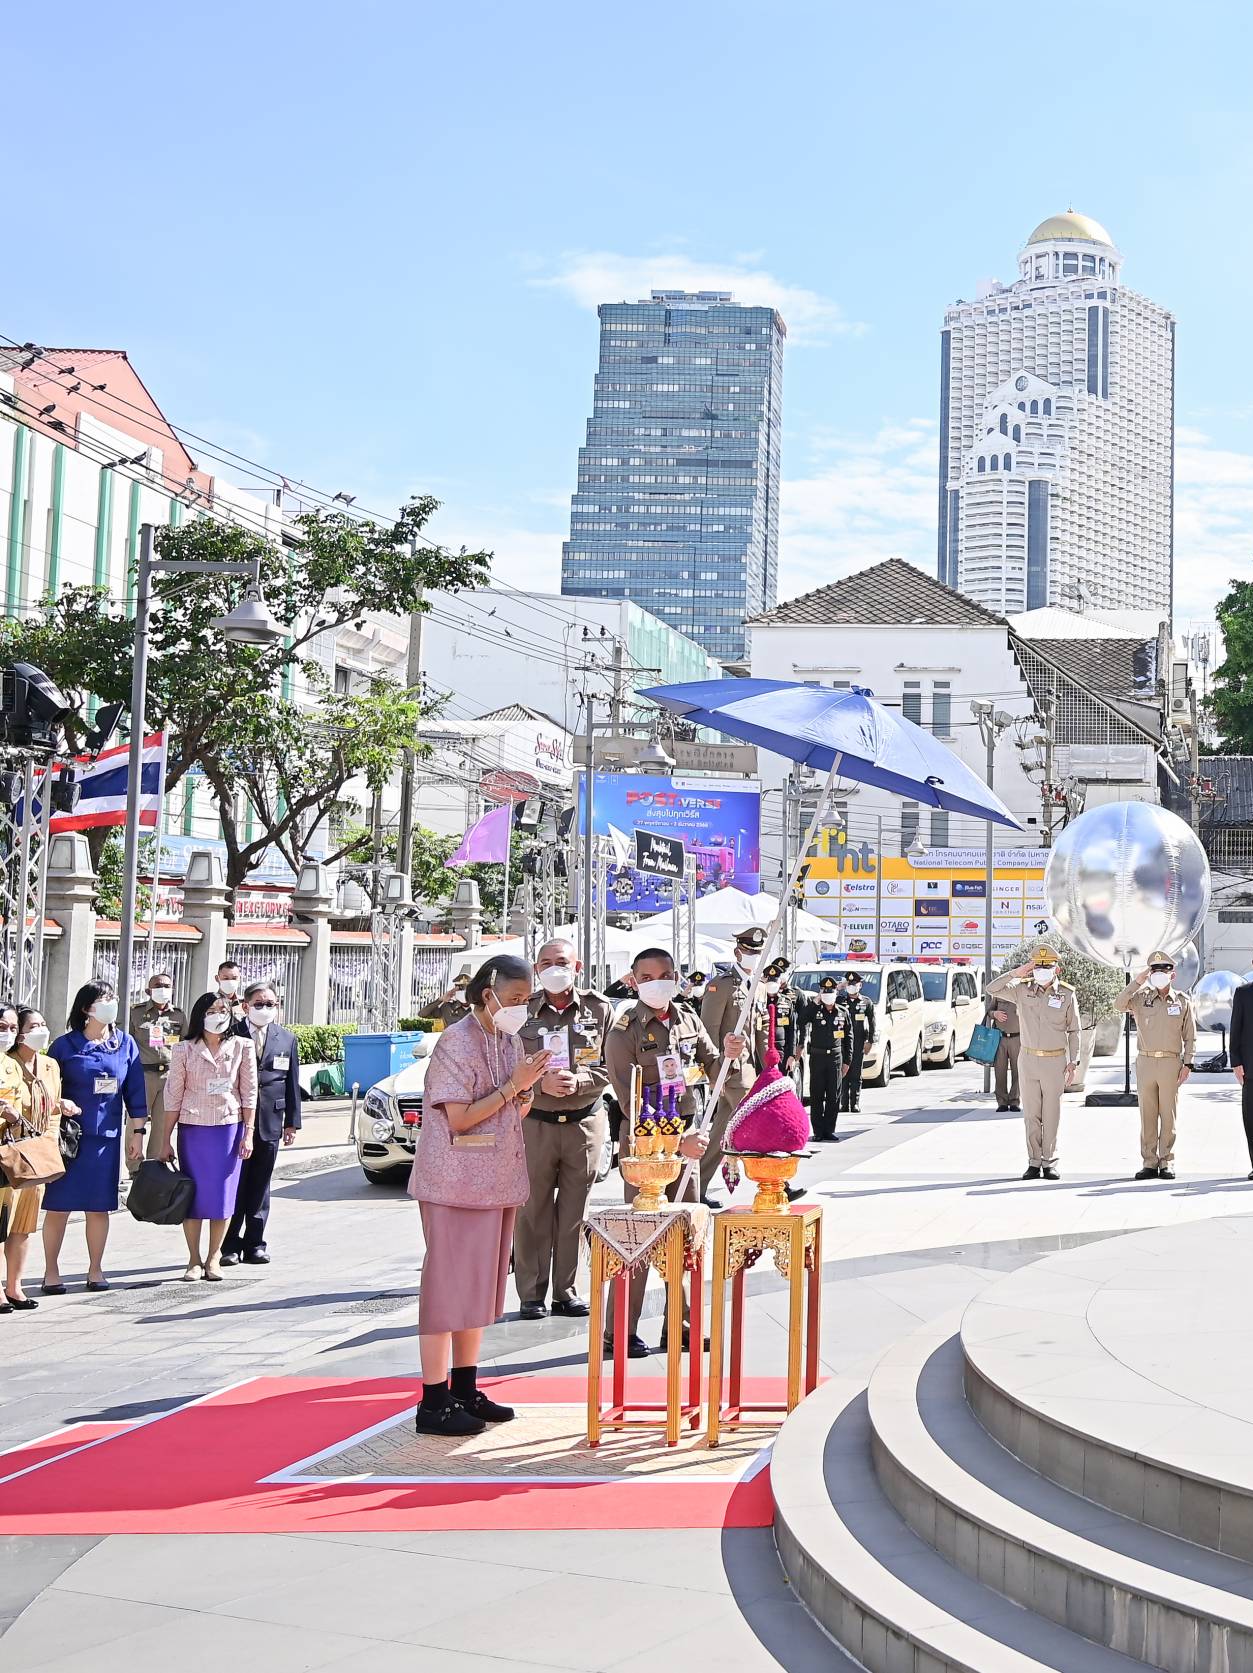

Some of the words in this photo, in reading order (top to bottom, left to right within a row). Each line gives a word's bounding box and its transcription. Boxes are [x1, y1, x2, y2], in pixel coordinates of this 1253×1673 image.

[837, 841, 876, 873] nt
[997, 859, 1029, 868] Company
[843, 883, 875, 893] Telstra
[880, 921, 910, 929] OTARO
